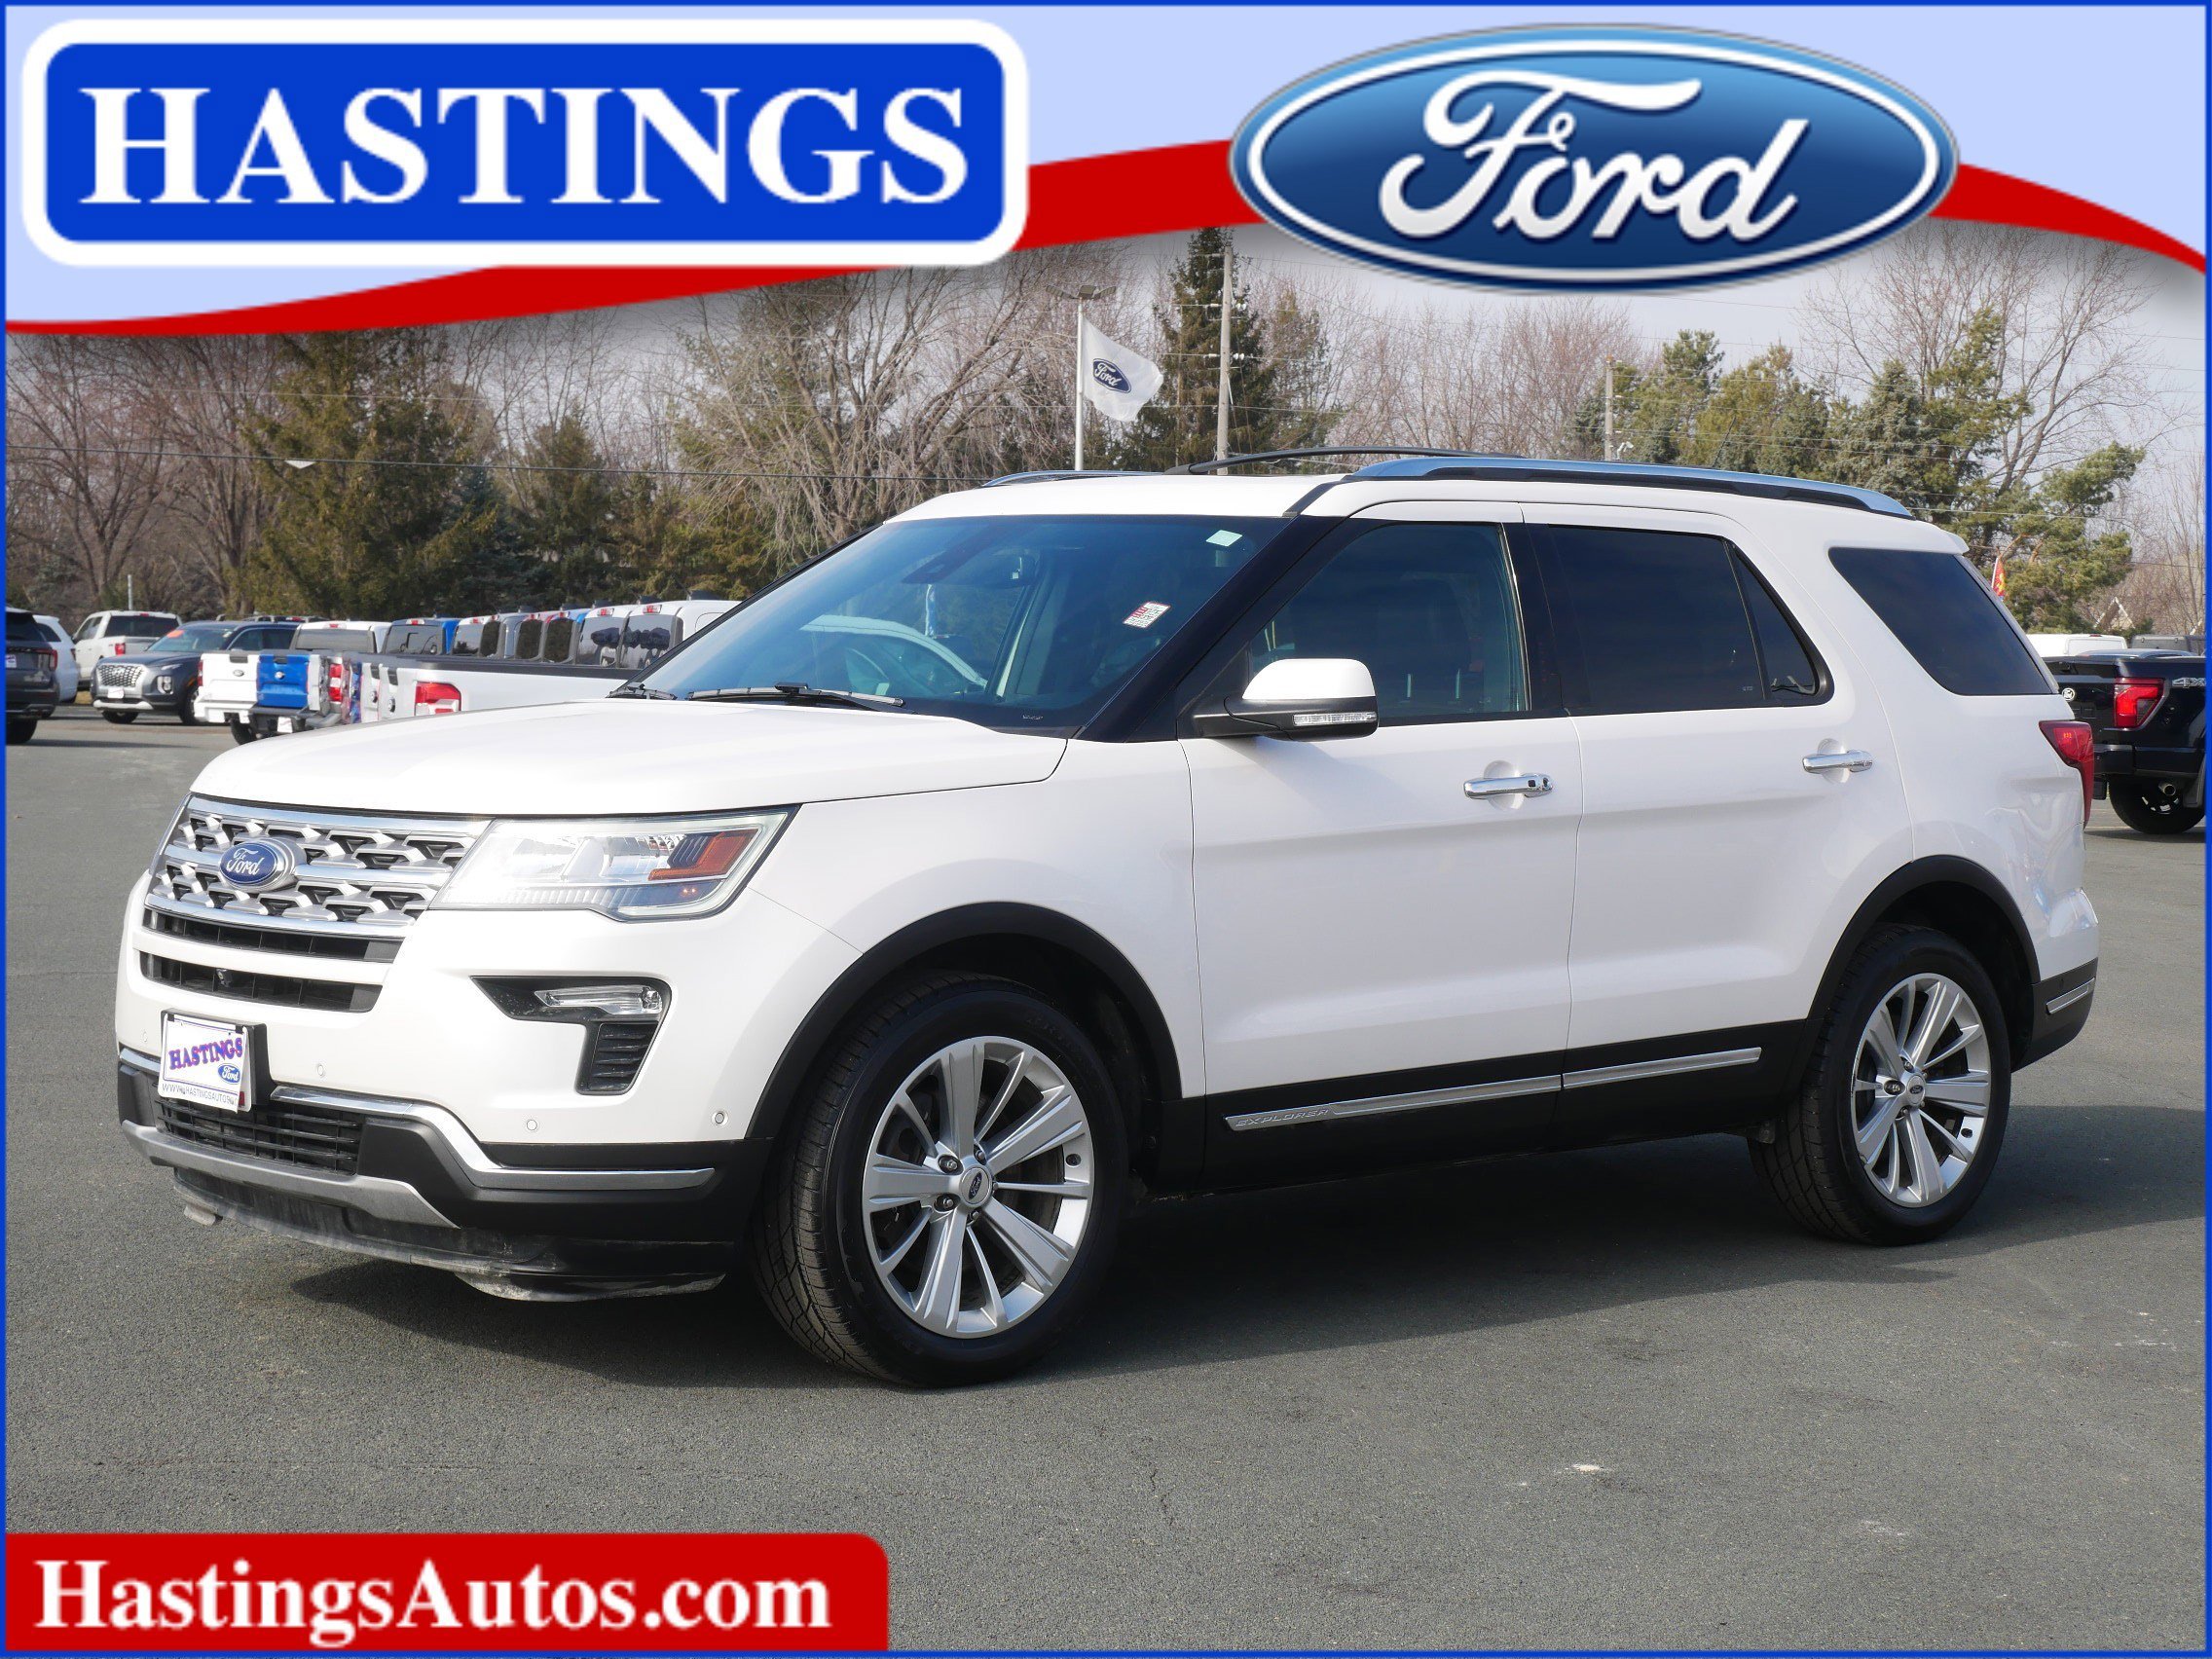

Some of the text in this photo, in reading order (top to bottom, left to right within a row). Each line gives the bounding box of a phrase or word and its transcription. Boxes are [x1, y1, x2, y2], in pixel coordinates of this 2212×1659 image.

[1095, 362, 1123, 387] Ford
[226, 847, 265, 875] Ford
[168, 1037, 242, 1070] HASTINGS
[222, 1065, 239, 1082] Ford
[1235, 1109, 1329, 1126] EXPLORER
